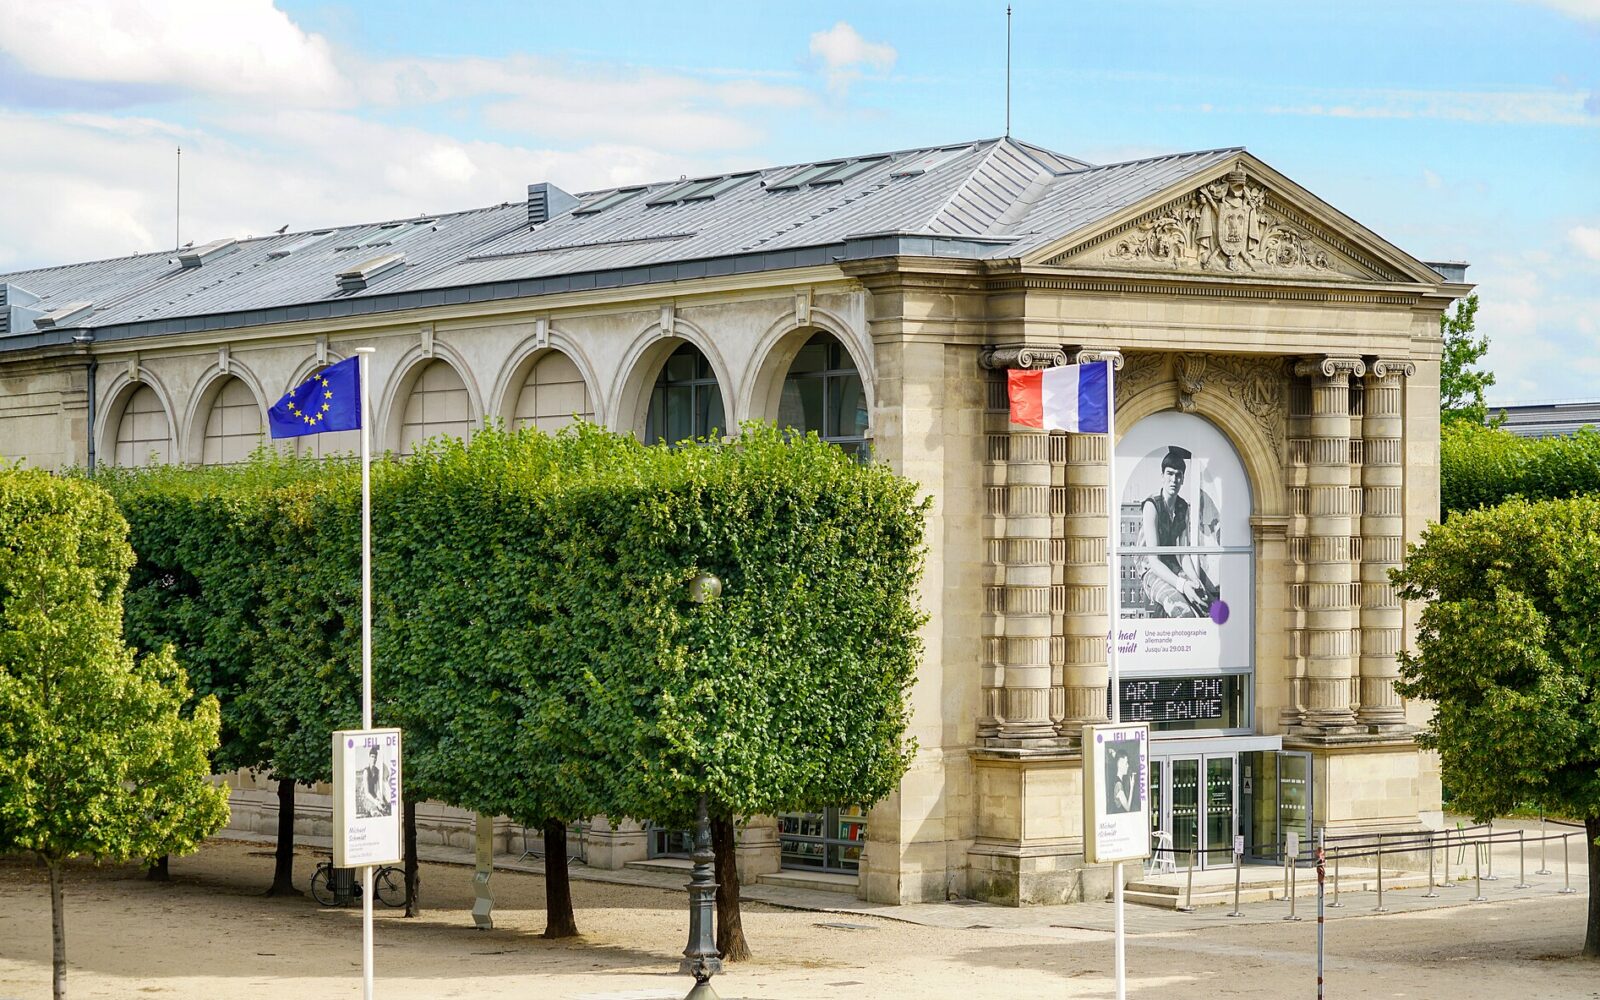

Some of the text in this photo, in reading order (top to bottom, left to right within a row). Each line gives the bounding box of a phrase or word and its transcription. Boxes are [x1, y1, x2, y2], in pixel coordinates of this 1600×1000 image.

[1106, 630, 1137, 641] Mhael
[1126, 681, 1160, 701] ART
[1131, 702, 1154, 721] DE
[1165, 700, 1221, 719] PAUME
[386, 736, 397, 746] DE
[1135, 730, 1146, 741] DE
